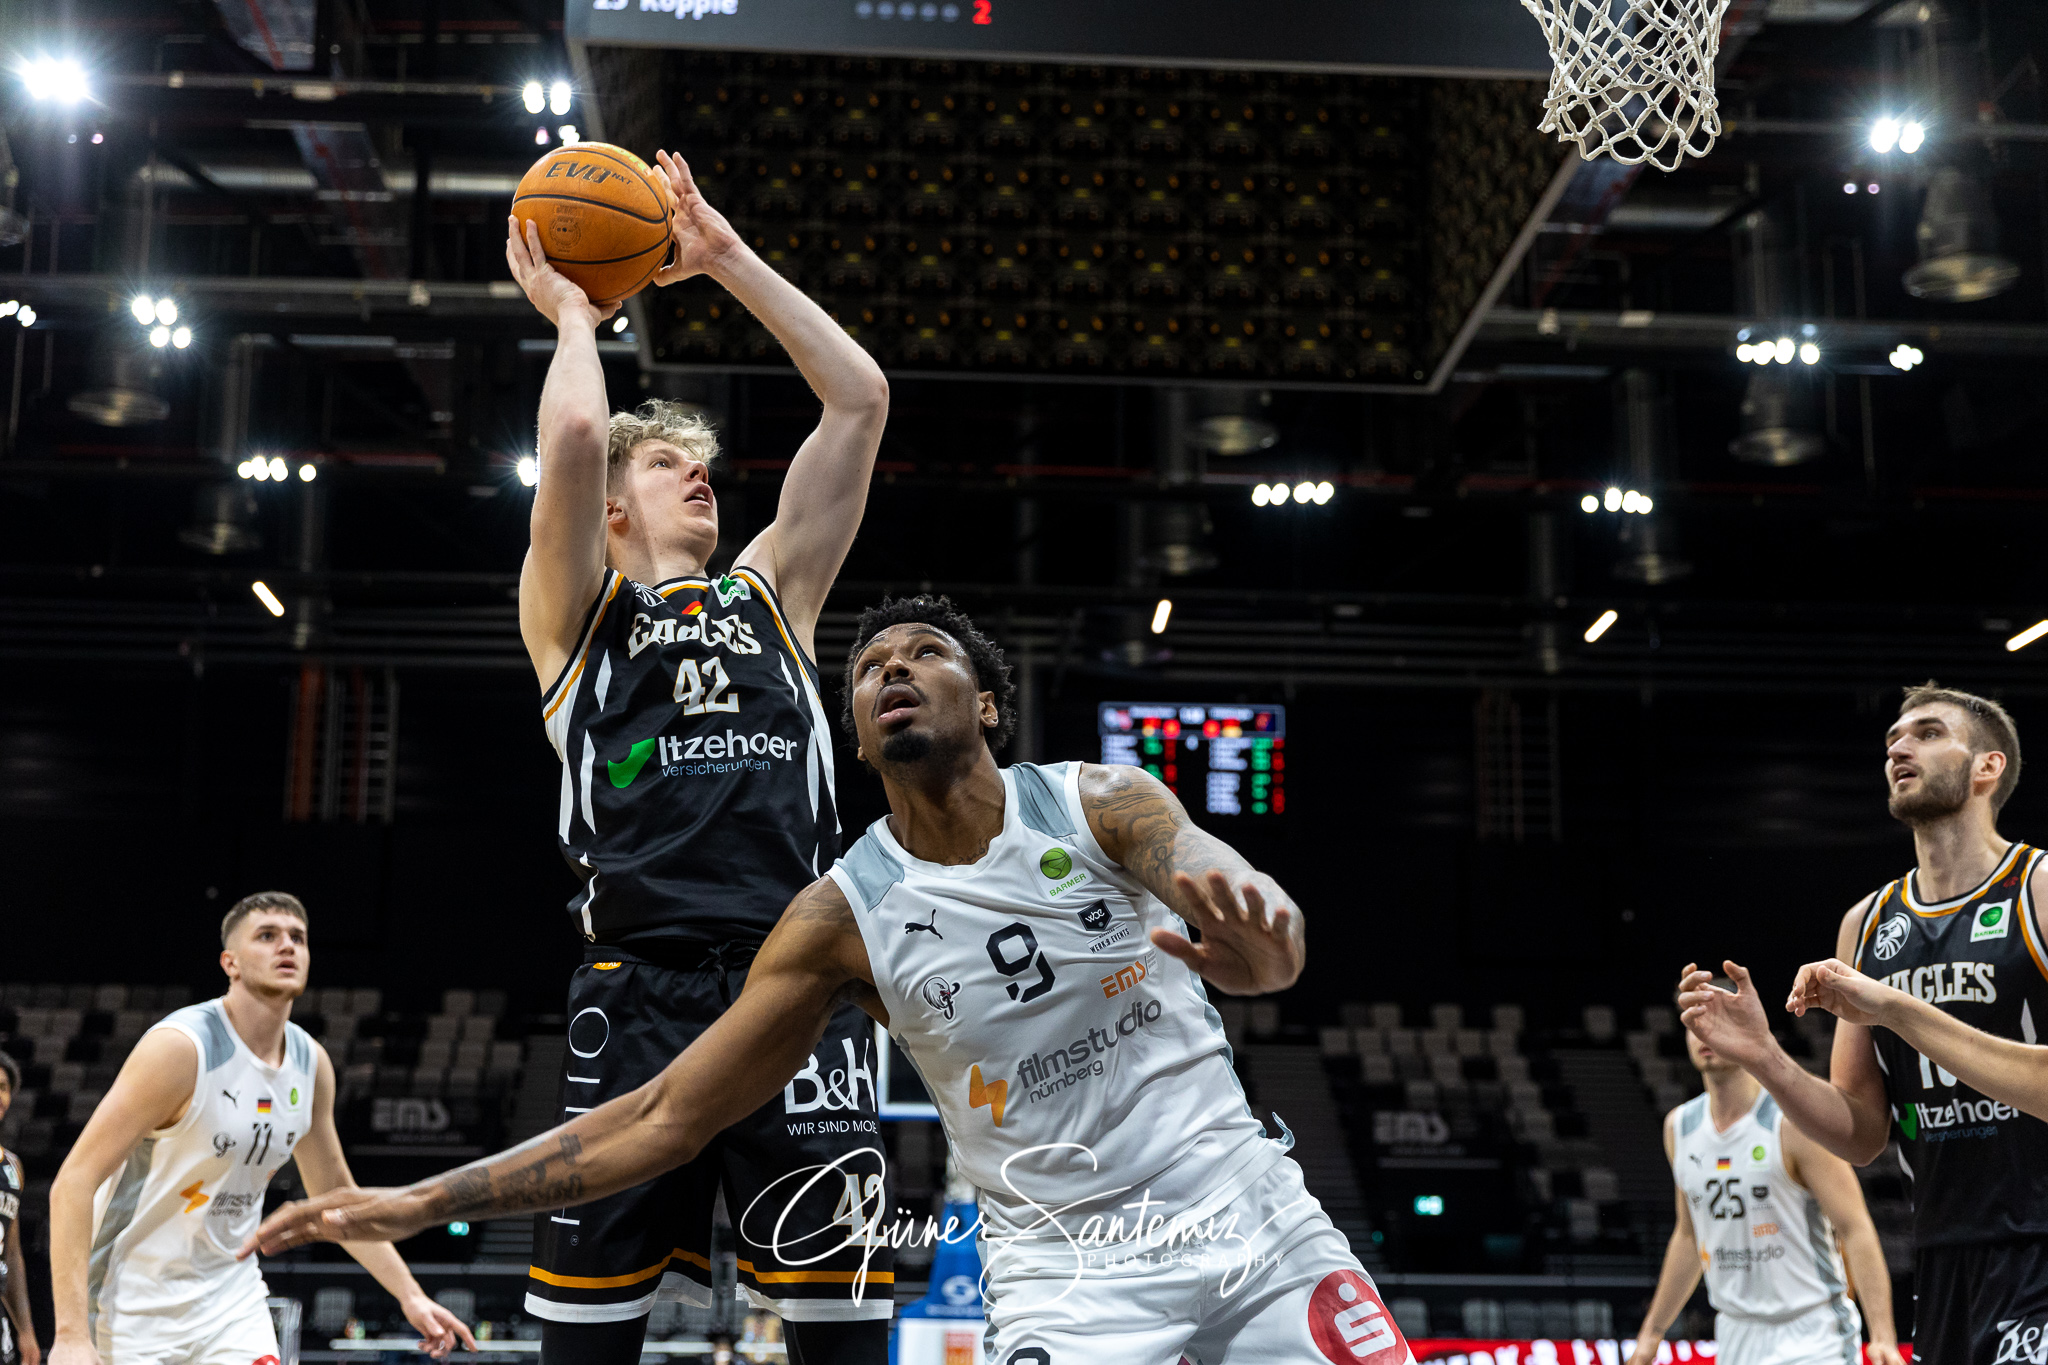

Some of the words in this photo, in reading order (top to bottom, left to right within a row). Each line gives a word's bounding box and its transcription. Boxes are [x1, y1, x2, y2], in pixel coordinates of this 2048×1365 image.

[972, 0, 992, 25] 2
[545, 162, 612, 184] EVO
[672, 656, 740, 716] 42
[658, 729, 798, 767] Itzehoer
[1049, 872, 1087, 897] BARMER
[1110, 927, 1130, 943] EVENTS
[985, 922, 1056, 1003] 9
[1099, 961, 1146, 999] EMS
[1879, 962, 1997, 1004] AGLES
[1016, 999, 1162, 1089] filmstudio
[784, 1037, 876, 1114] B&H
[1029, 1057, 1105, 1103] nürnberg
[244, 1123, 272, 1166] 11
[787, 1121, 815, 1136] WIR
[817, 1120, 850, 1134] SIND
[833, 1173, 888, 1247] 42
[1705, 1178, 1746, 1220] 25
